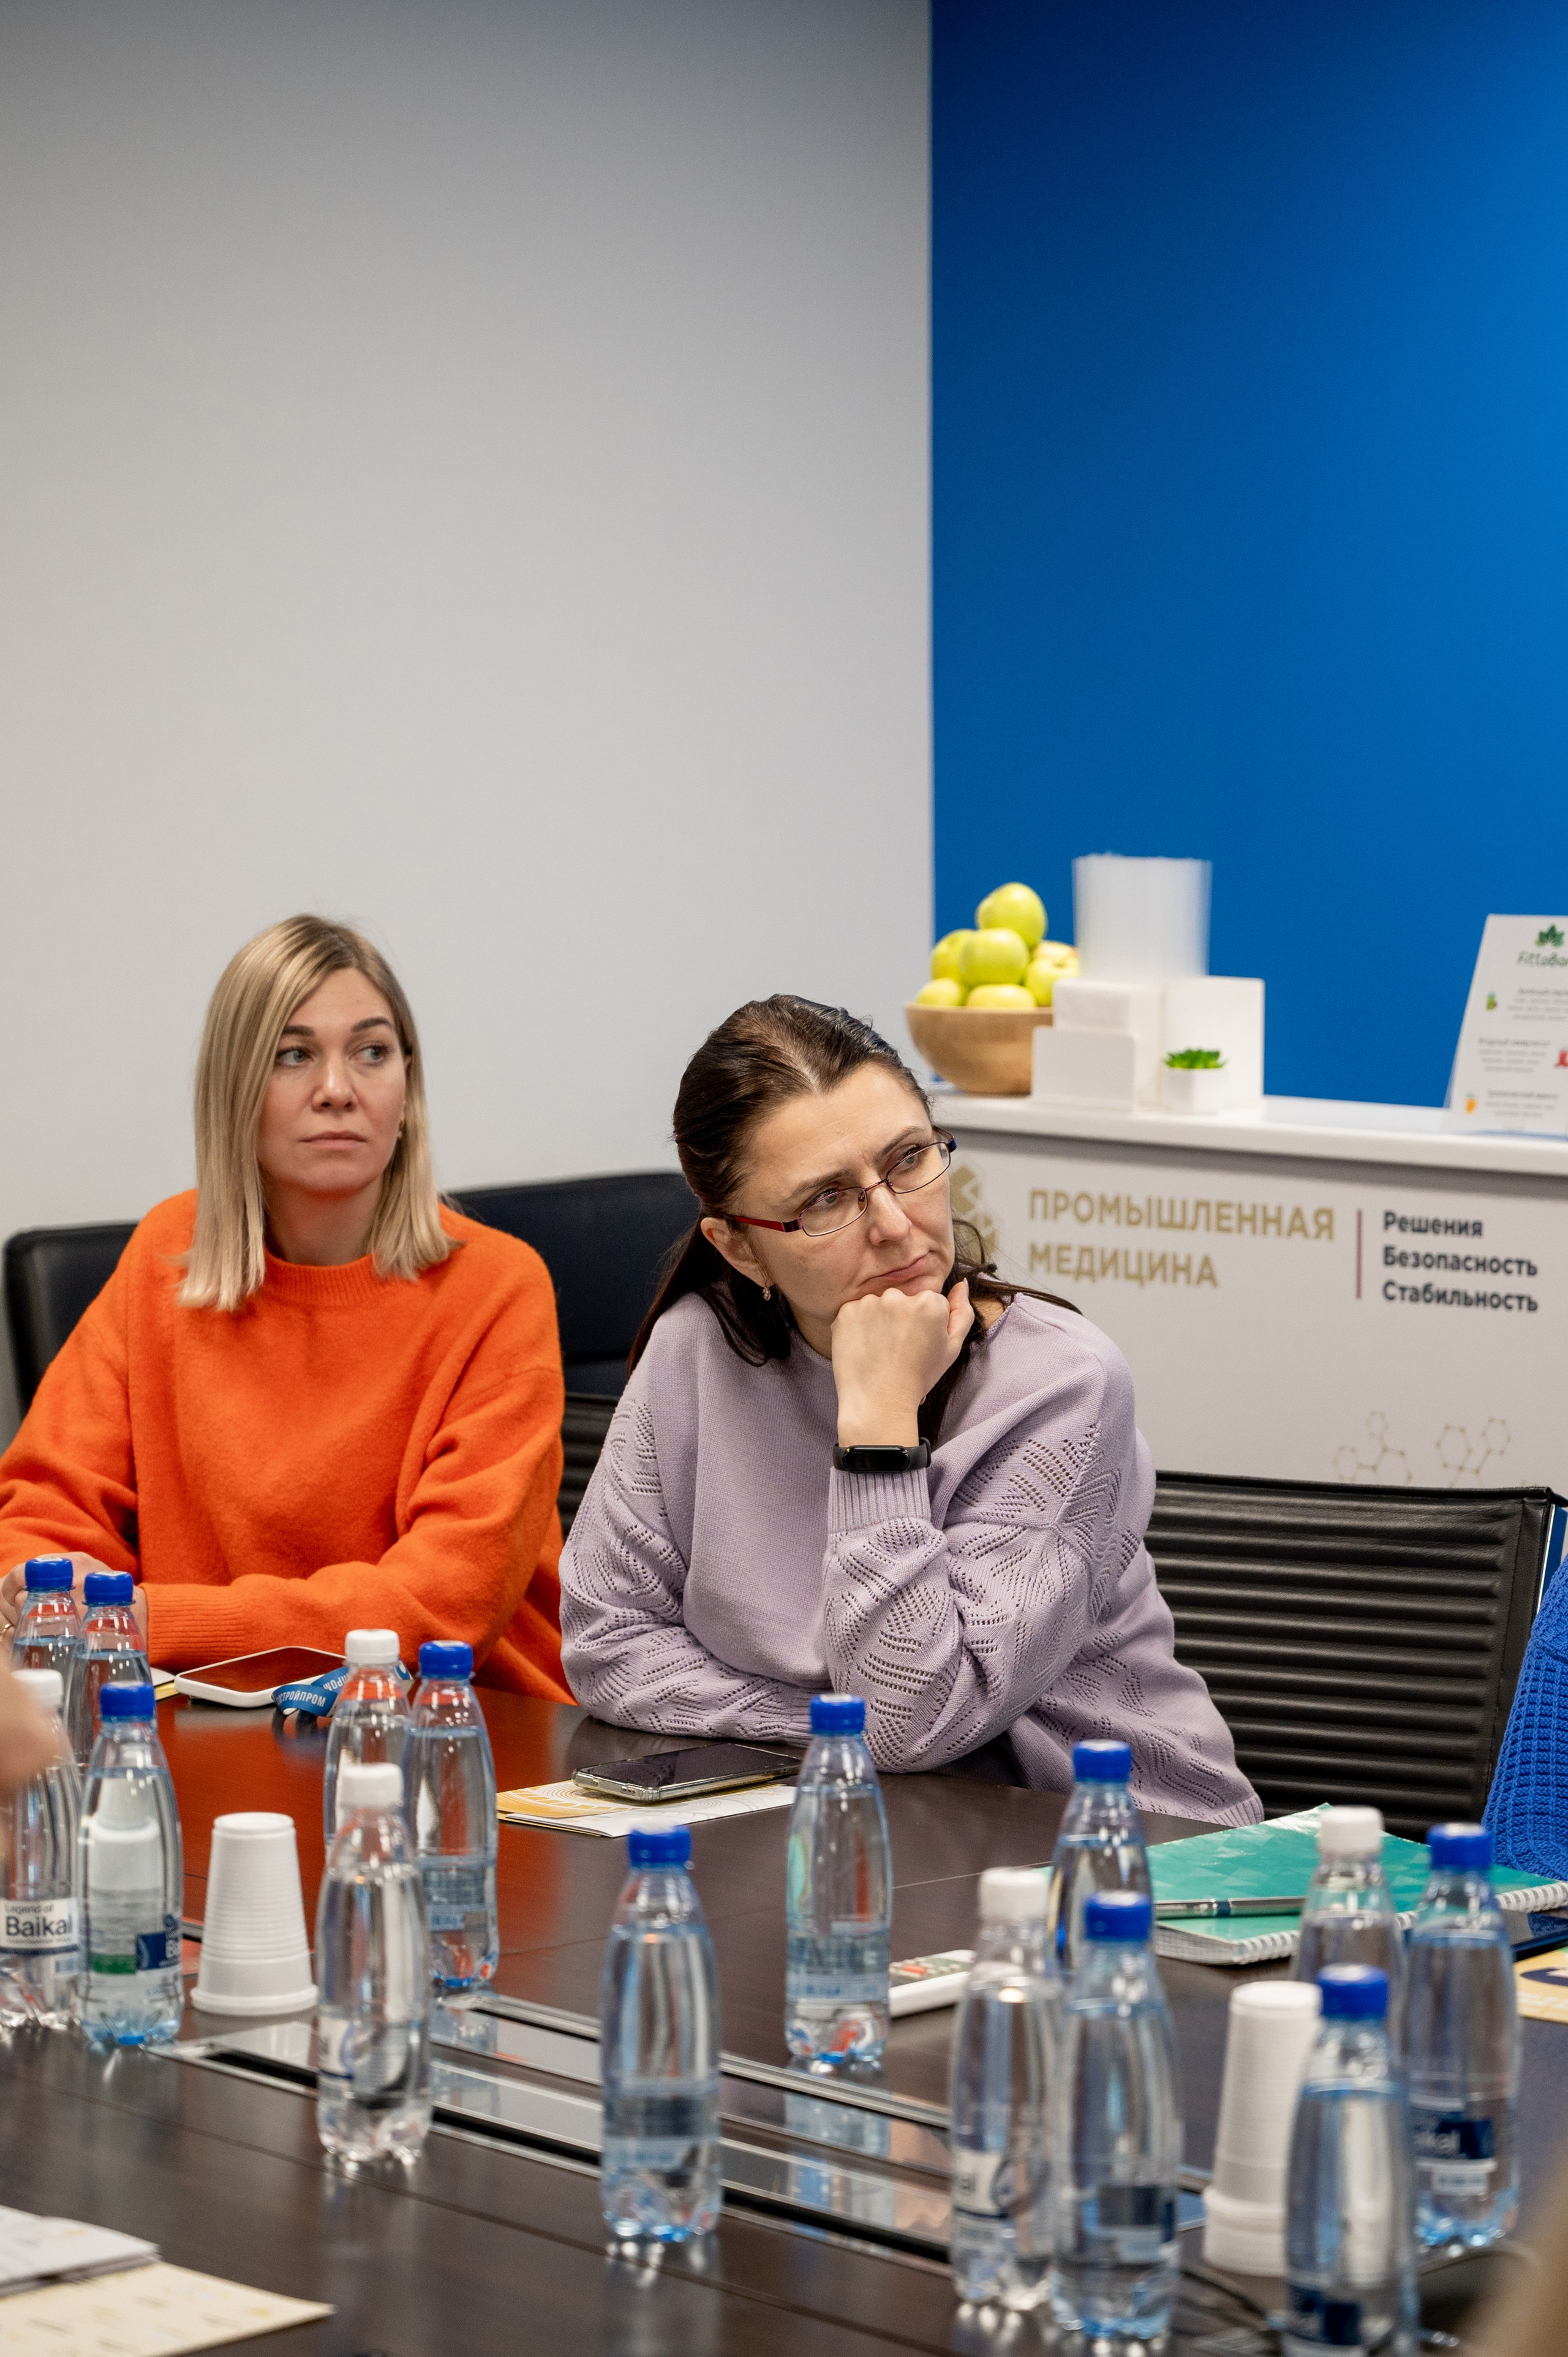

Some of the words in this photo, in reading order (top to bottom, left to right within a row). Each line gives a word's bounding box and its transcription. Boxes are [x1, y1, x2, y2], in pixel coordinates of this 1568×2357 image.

[1029, 1189, 1335, 1240] ПРОМЫШЛЕННАЯ
[1384, 1210, 1483, 1237] Решения
[1028, 1242, 1218, 1287] МЕДИЦИНА
[1383, 1245, 1538, 1276] Безопасность
[1383, 1280, 1539, 1312] Стабильность
[6, 1914, 73, 1937] Baikal
